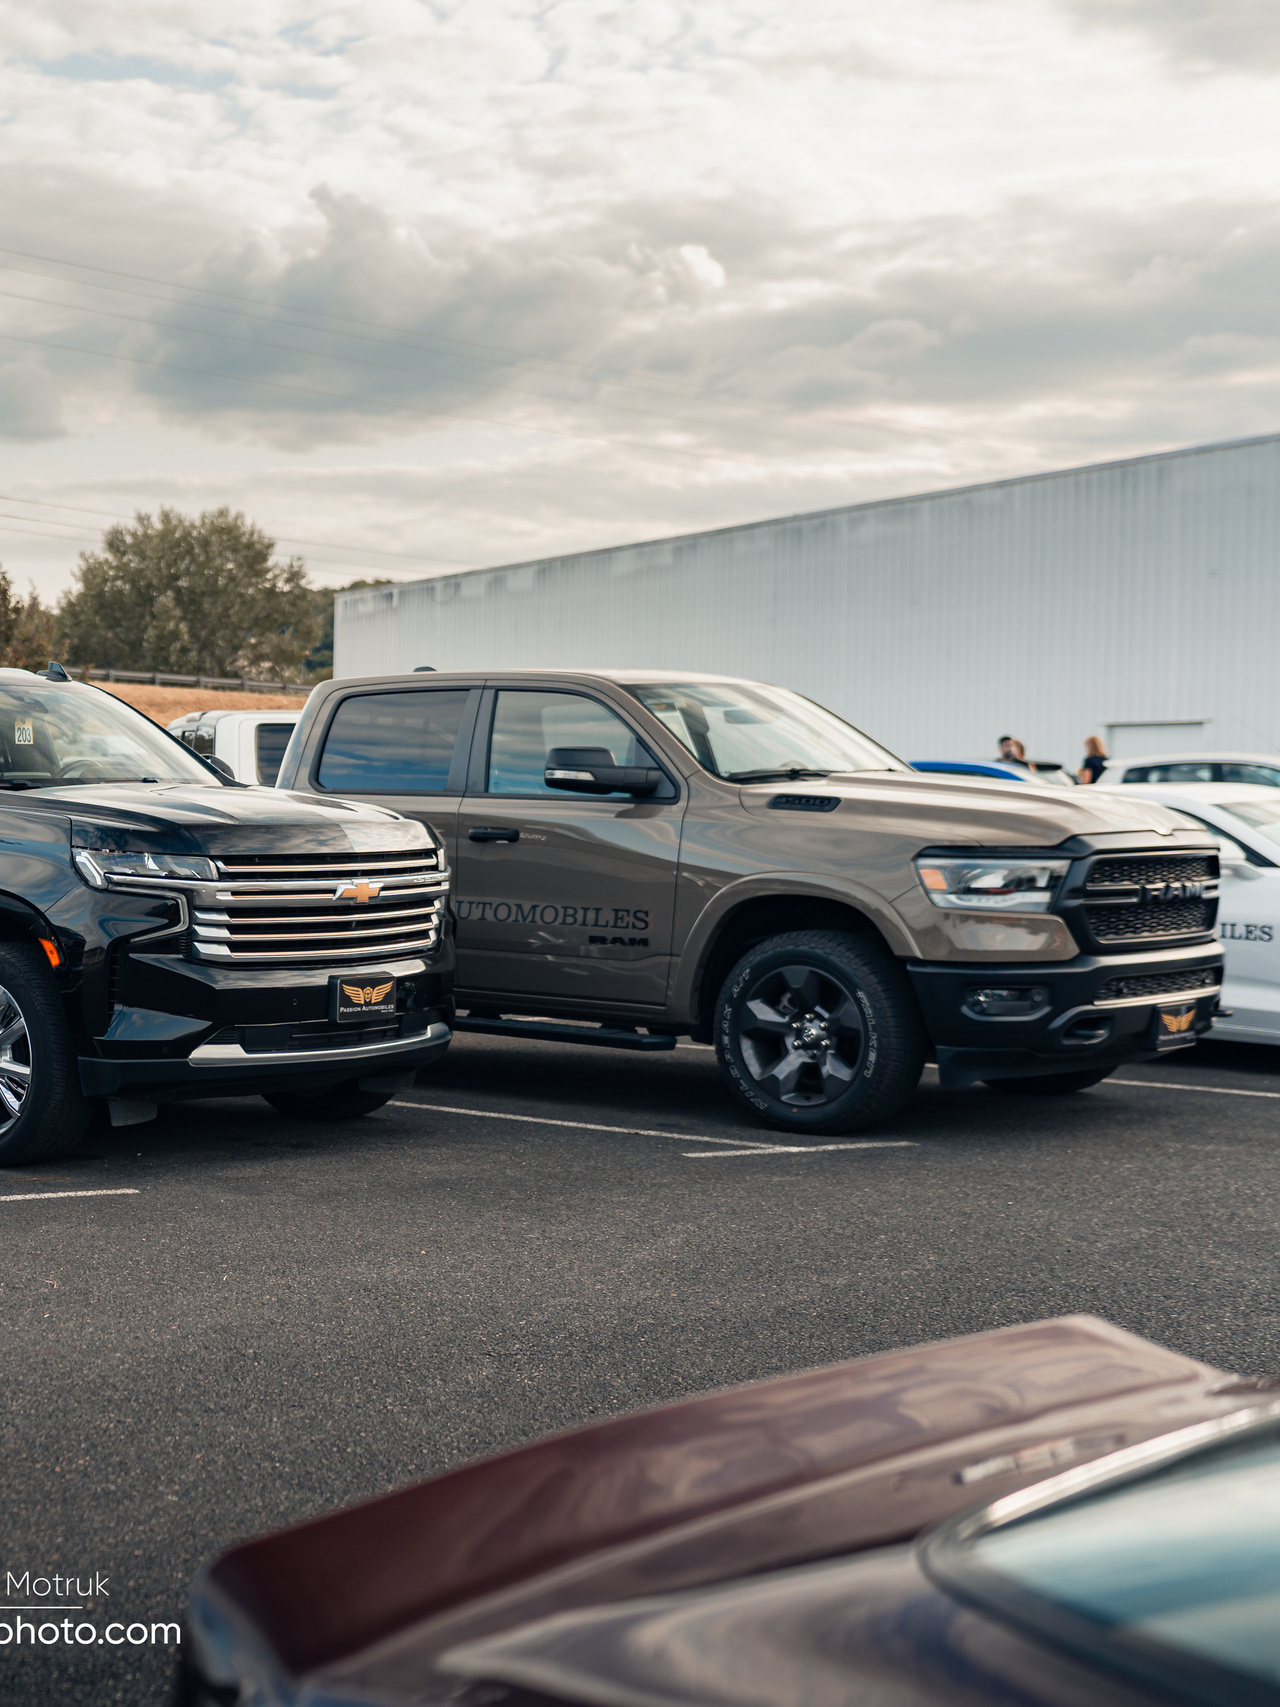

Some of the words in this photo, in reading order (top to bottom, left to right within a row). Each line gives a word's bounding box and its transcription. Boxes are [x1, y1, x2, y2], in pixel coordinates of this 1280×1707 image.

[16, 727, 31, 743] 203
[455, 900, 650, 931] UTOMOBILES
[588, 935, 650, 947] RAM
